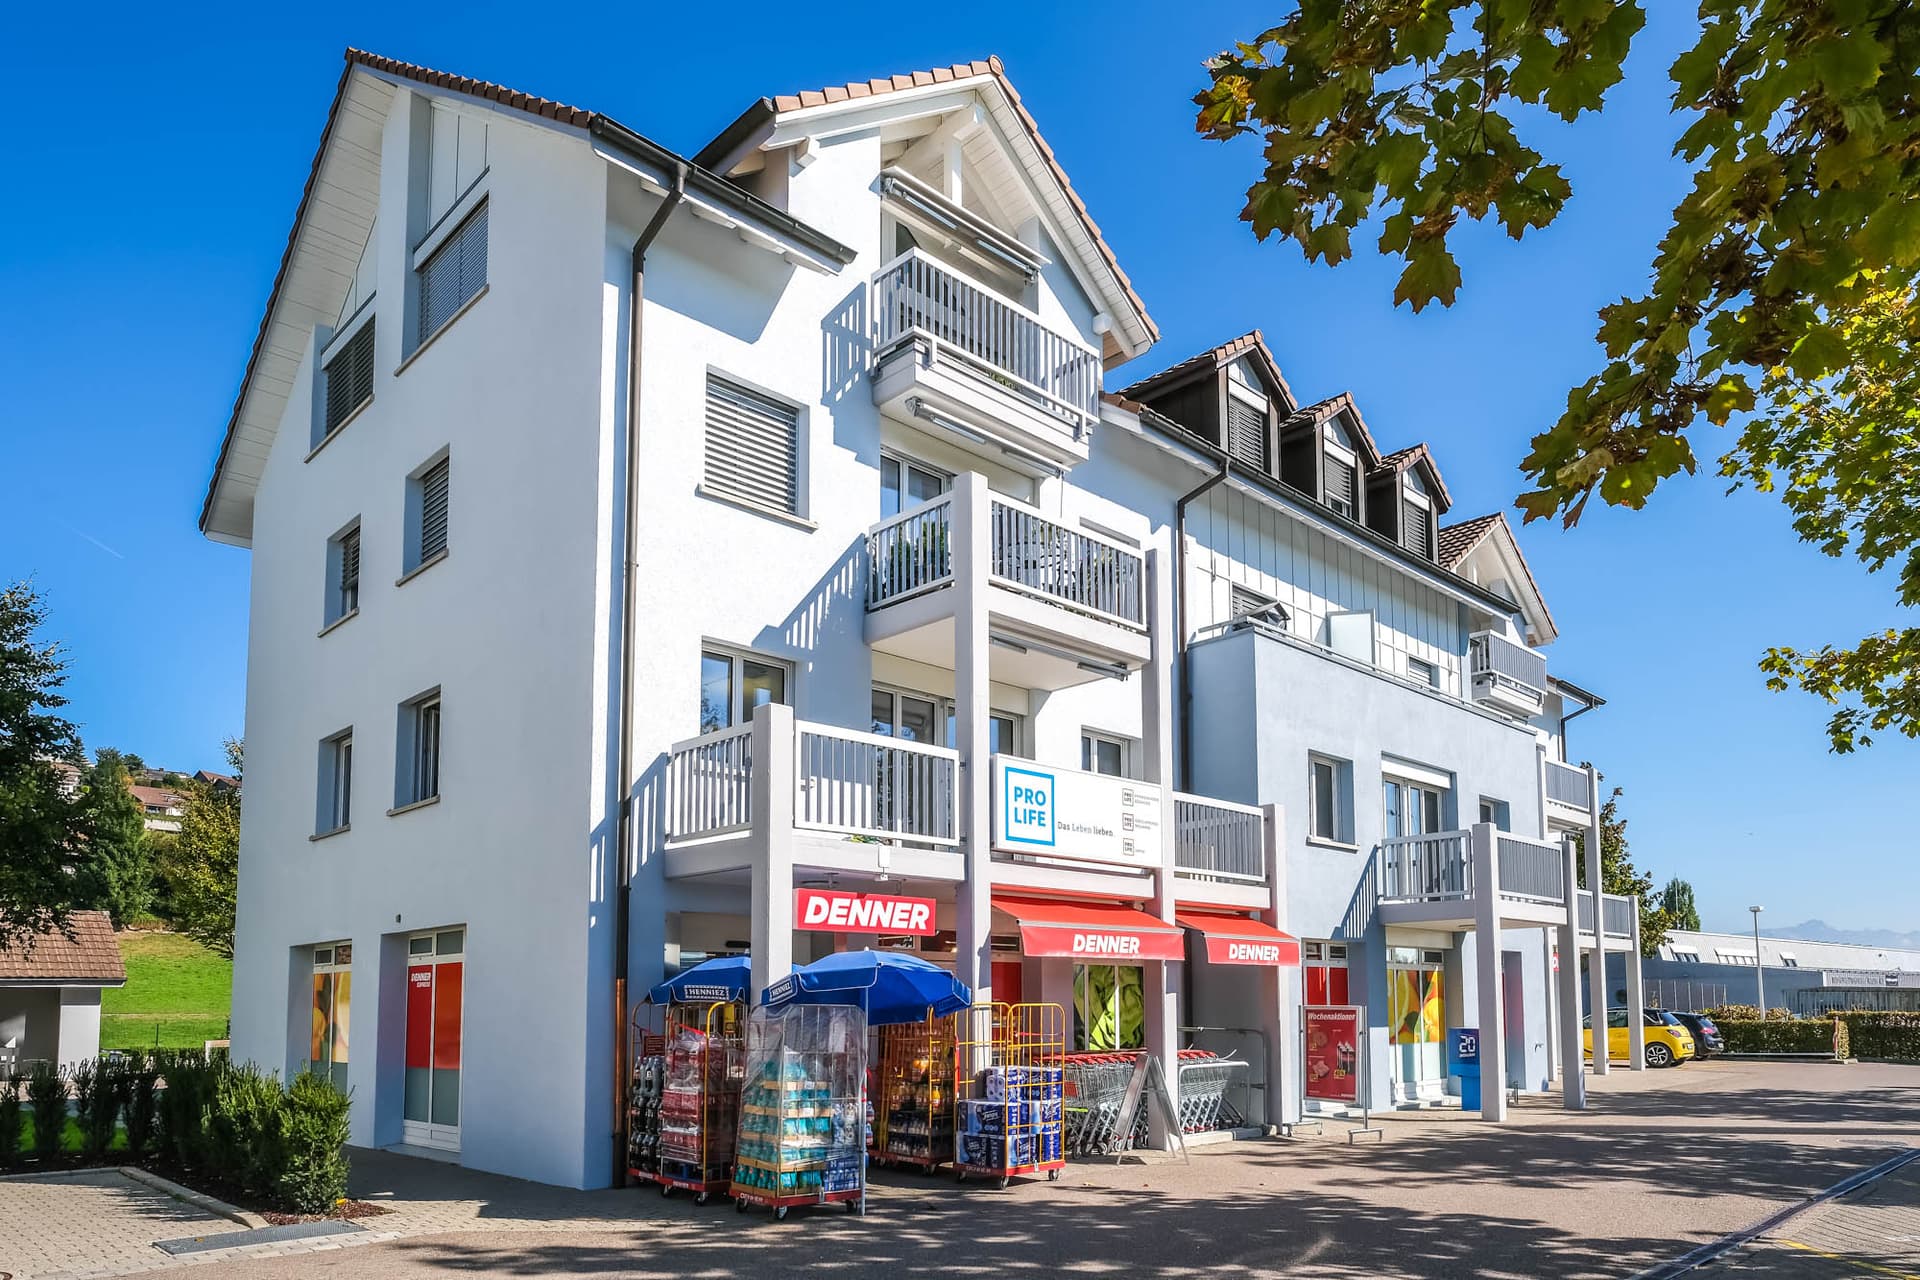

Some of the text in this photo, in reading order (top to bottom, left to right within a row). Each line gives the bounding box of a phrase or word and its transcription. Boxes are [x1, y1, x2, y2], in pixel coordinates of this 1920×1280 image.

[1014, 786, 1046, 806] PRO
[1014, 807, 1046, 827] LIFE
[1057, 821, 1070, 831] Das
[1072, 823, 1092, 834] Leben
[804, 896, 930, 930] DENNER
[1073, 934, 1140, 954] DENNER
[1228, 944, 1280, 961] DENNER
[689, 988, 725, 998] HENNIEZ
[771, 982, 791, 996] HENNIEZ
[1459, 1035, 1476, 1053] 20
